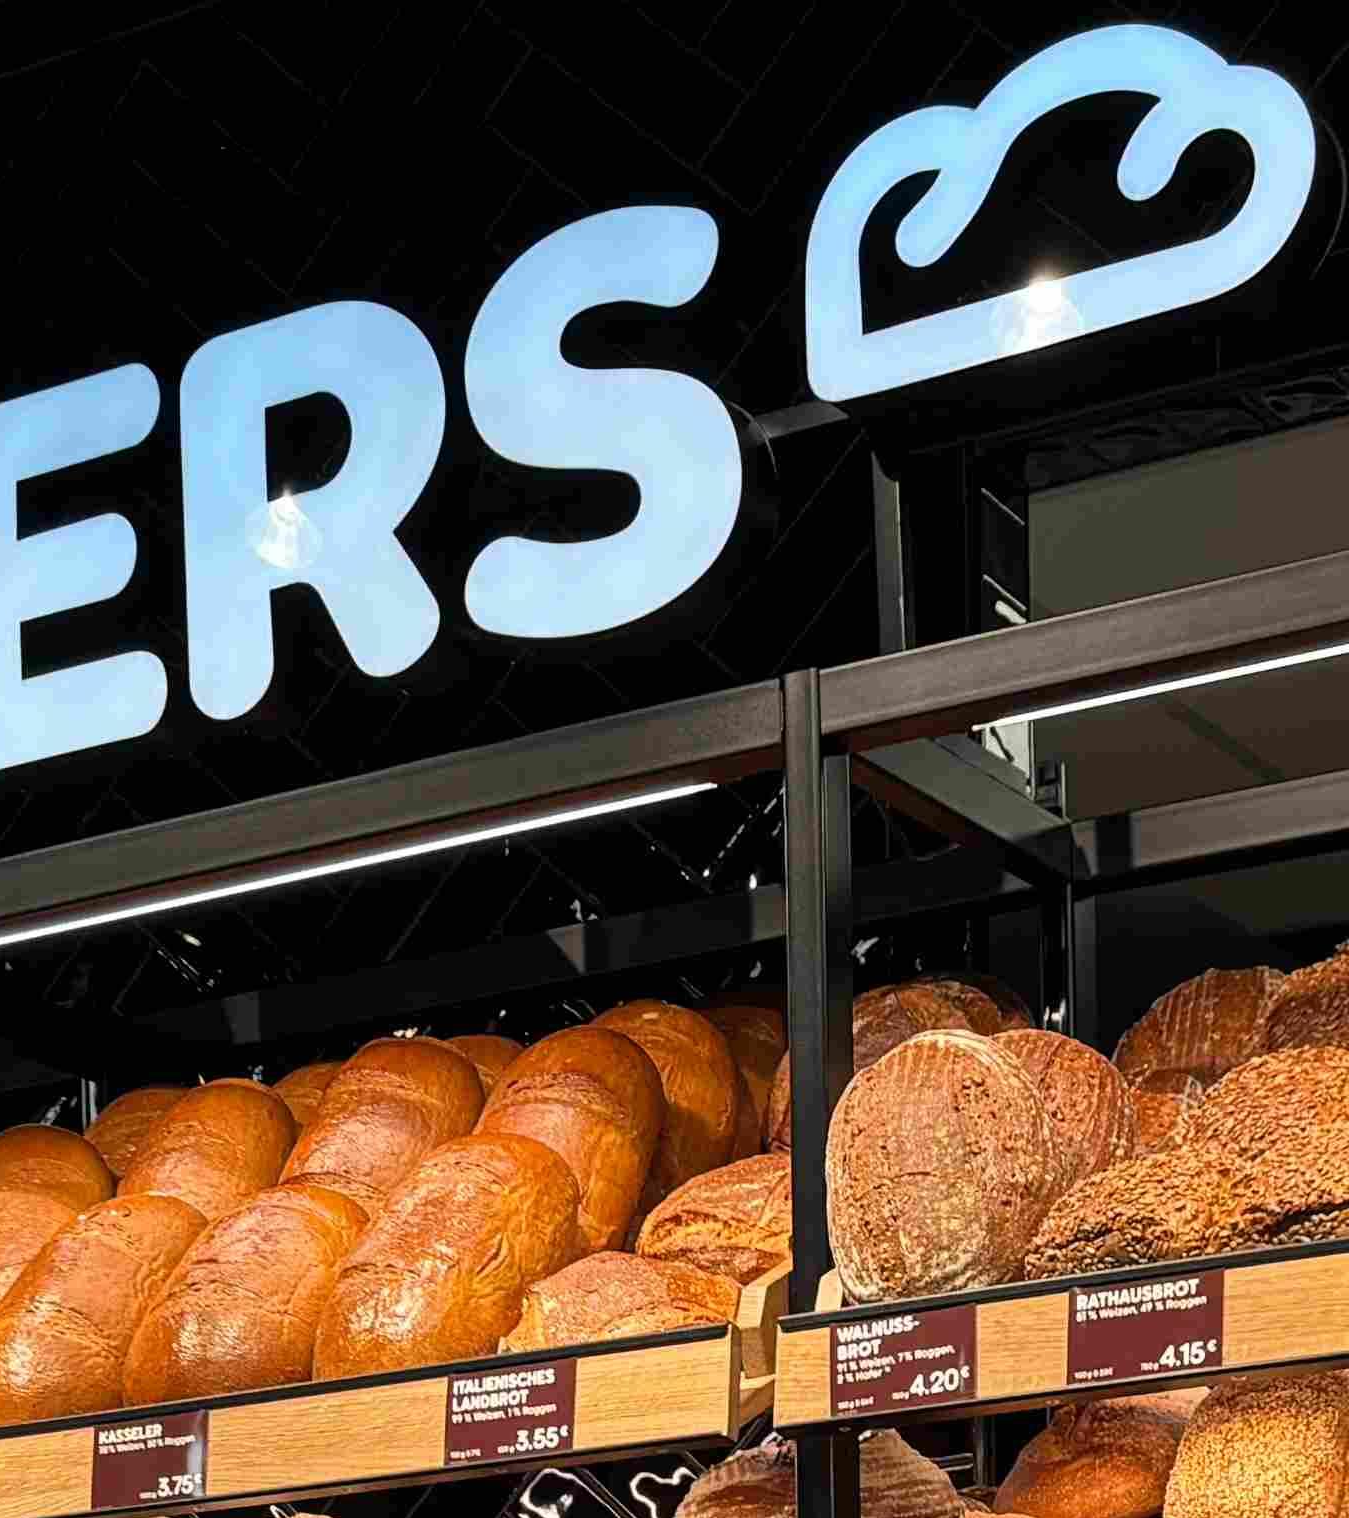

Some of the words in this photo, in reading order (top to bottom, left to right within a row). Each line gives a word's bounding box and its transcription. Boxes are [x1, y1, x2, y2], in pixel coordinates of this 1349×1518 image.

[1076, 1278, 1200, 1311] RATHAUSBROT
[1099, 1306, 1139, 1319] Weizen,
[1165, 1295, 1208, 1310] Roggen
[836, 1315, 920, 1343] WALNUSS-
[837, 1339, 881, 1361] BROT
[453, 1368, 556, 1395] ITALIENISCHES
[452, 1389, 530, 1413] LANDBROT
[522, 1403, 558, 1417] Roggen
[98, 1423, 163, 1445] KASSELER
